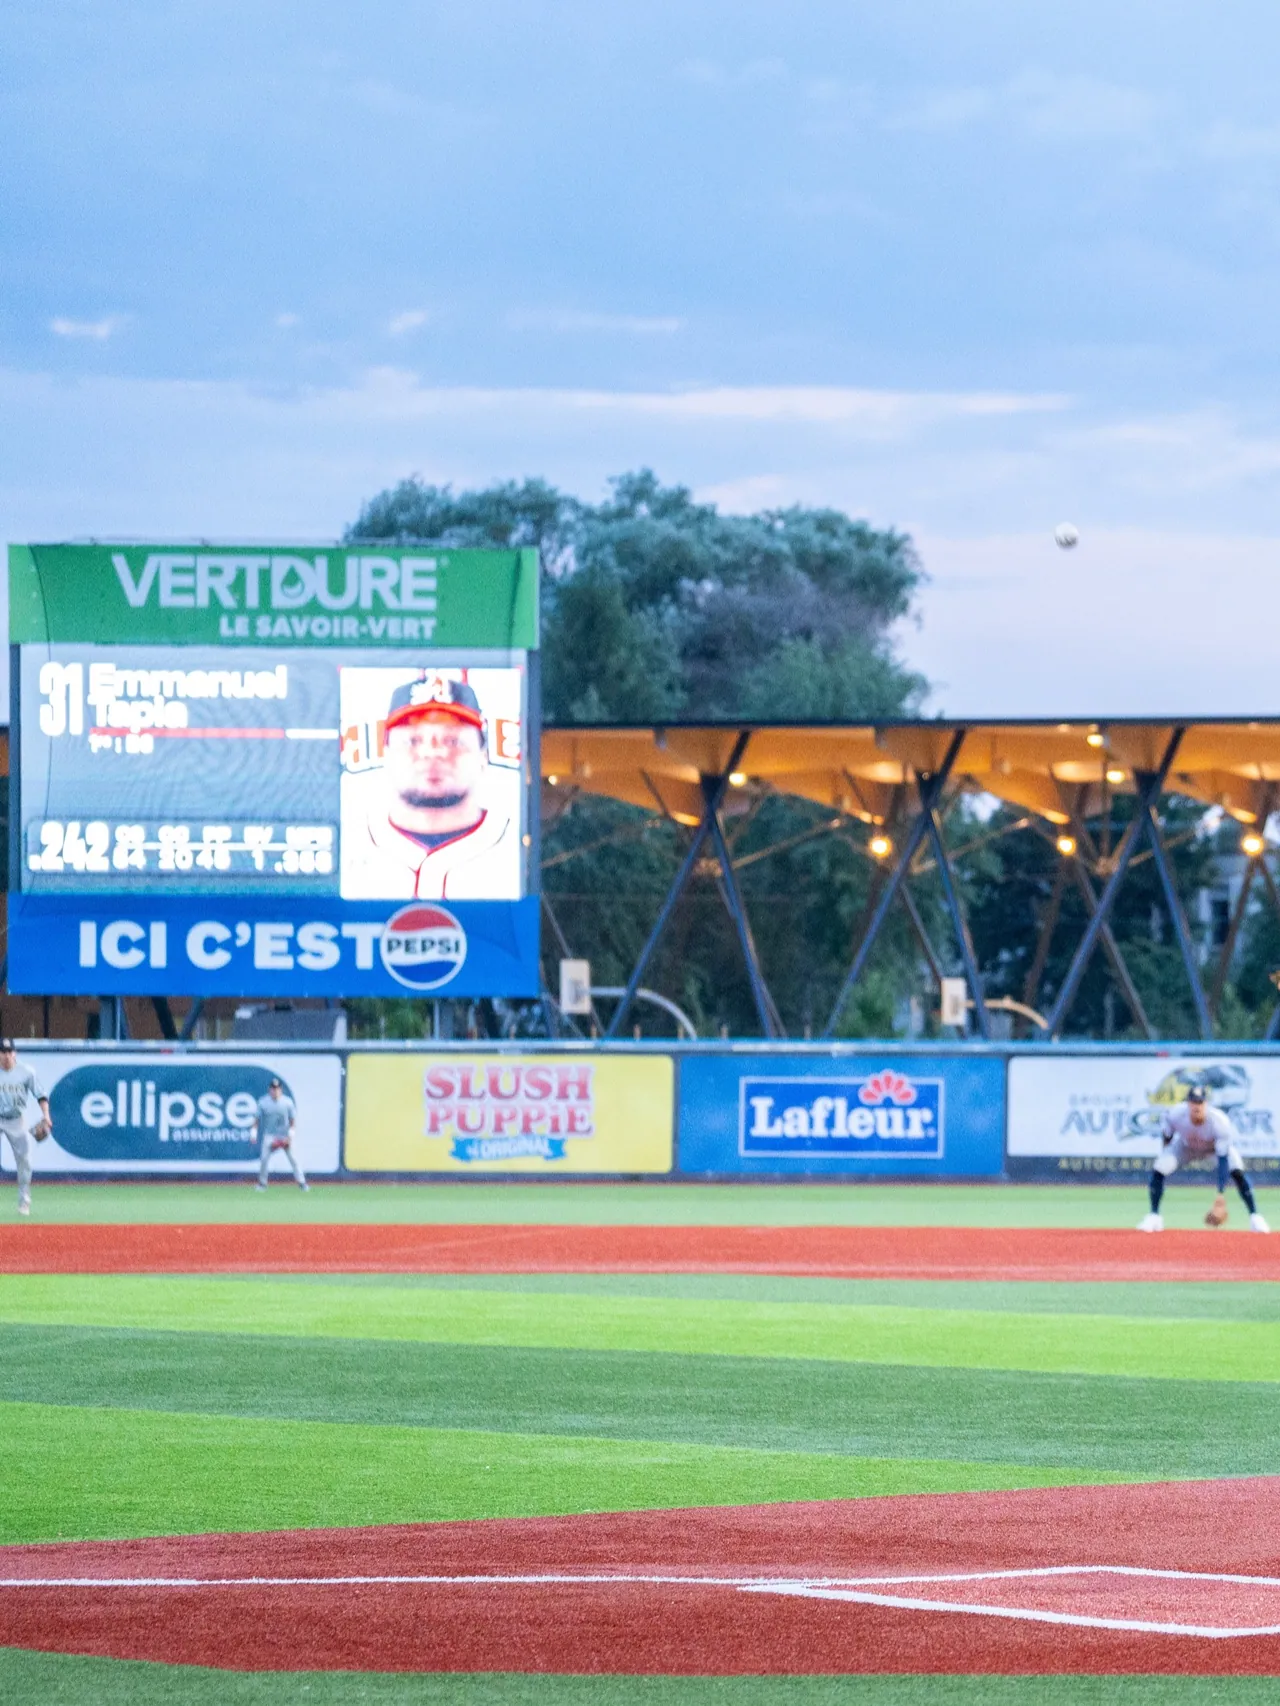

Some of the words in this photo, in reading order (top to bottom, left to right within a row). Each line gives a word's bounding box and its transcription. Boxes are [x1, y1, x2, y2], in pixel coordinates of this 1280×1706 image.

[112, 554, 438, 612] VERTDURE
[219, 615, 250, 637] LE
[254, 615, 437, 640] SAVOIR-VERT
[39, 661, 83, 736] 31
[89, 662, 288, 699] Emmanuel
[79, 921, 168, 969] ICI
[186, 921, 385, 969] C'EST
[386, 937, 461, 956] PEPSI
[424, 1063, 594, 1102] SLUSH
[81, 1080, 258, 1142] ellipse
[749, 1096, 931, 1140] Lafleur
